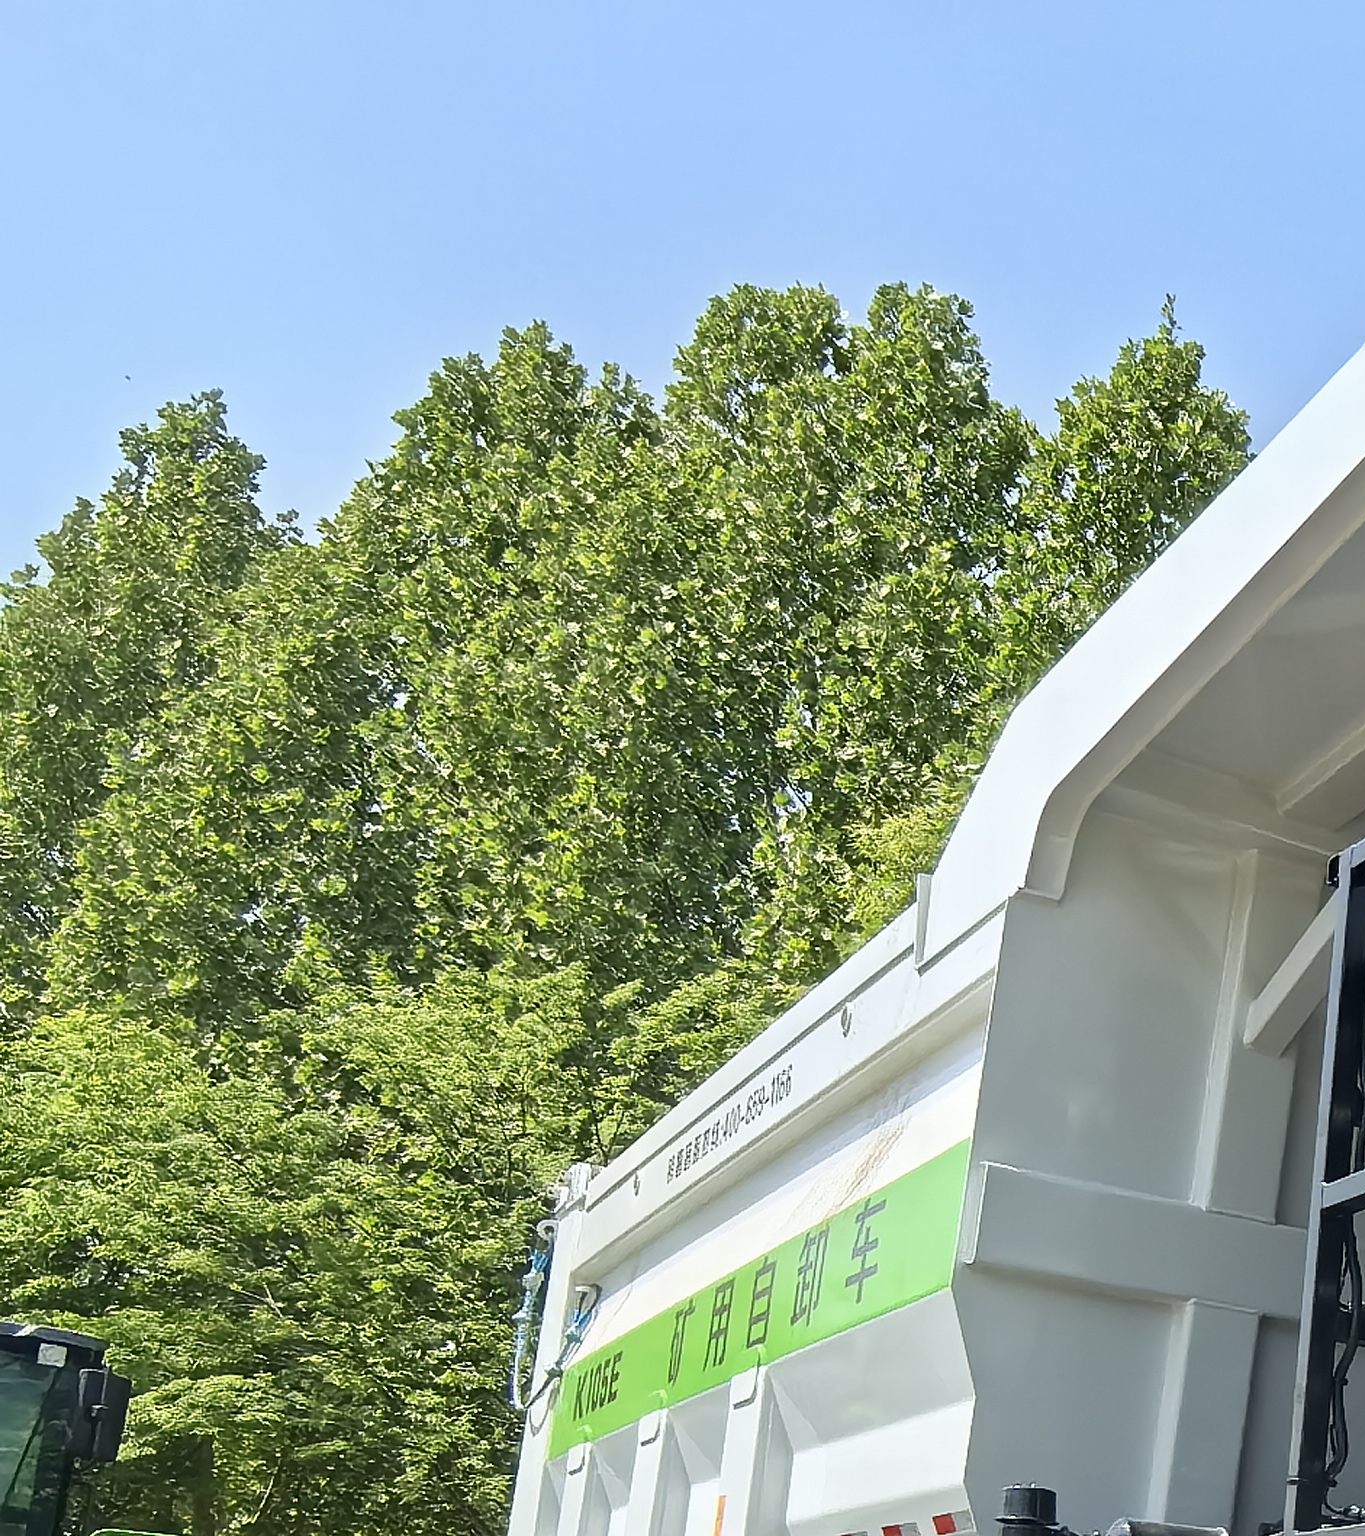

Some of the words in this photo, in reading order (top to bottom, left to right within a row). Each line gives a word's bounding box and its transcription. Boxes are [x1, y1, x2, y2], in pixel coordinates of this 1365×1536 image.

[667, 1198, 888, 1387] 矿用自卸车
[572, 1350, 624, 1422] K105E
